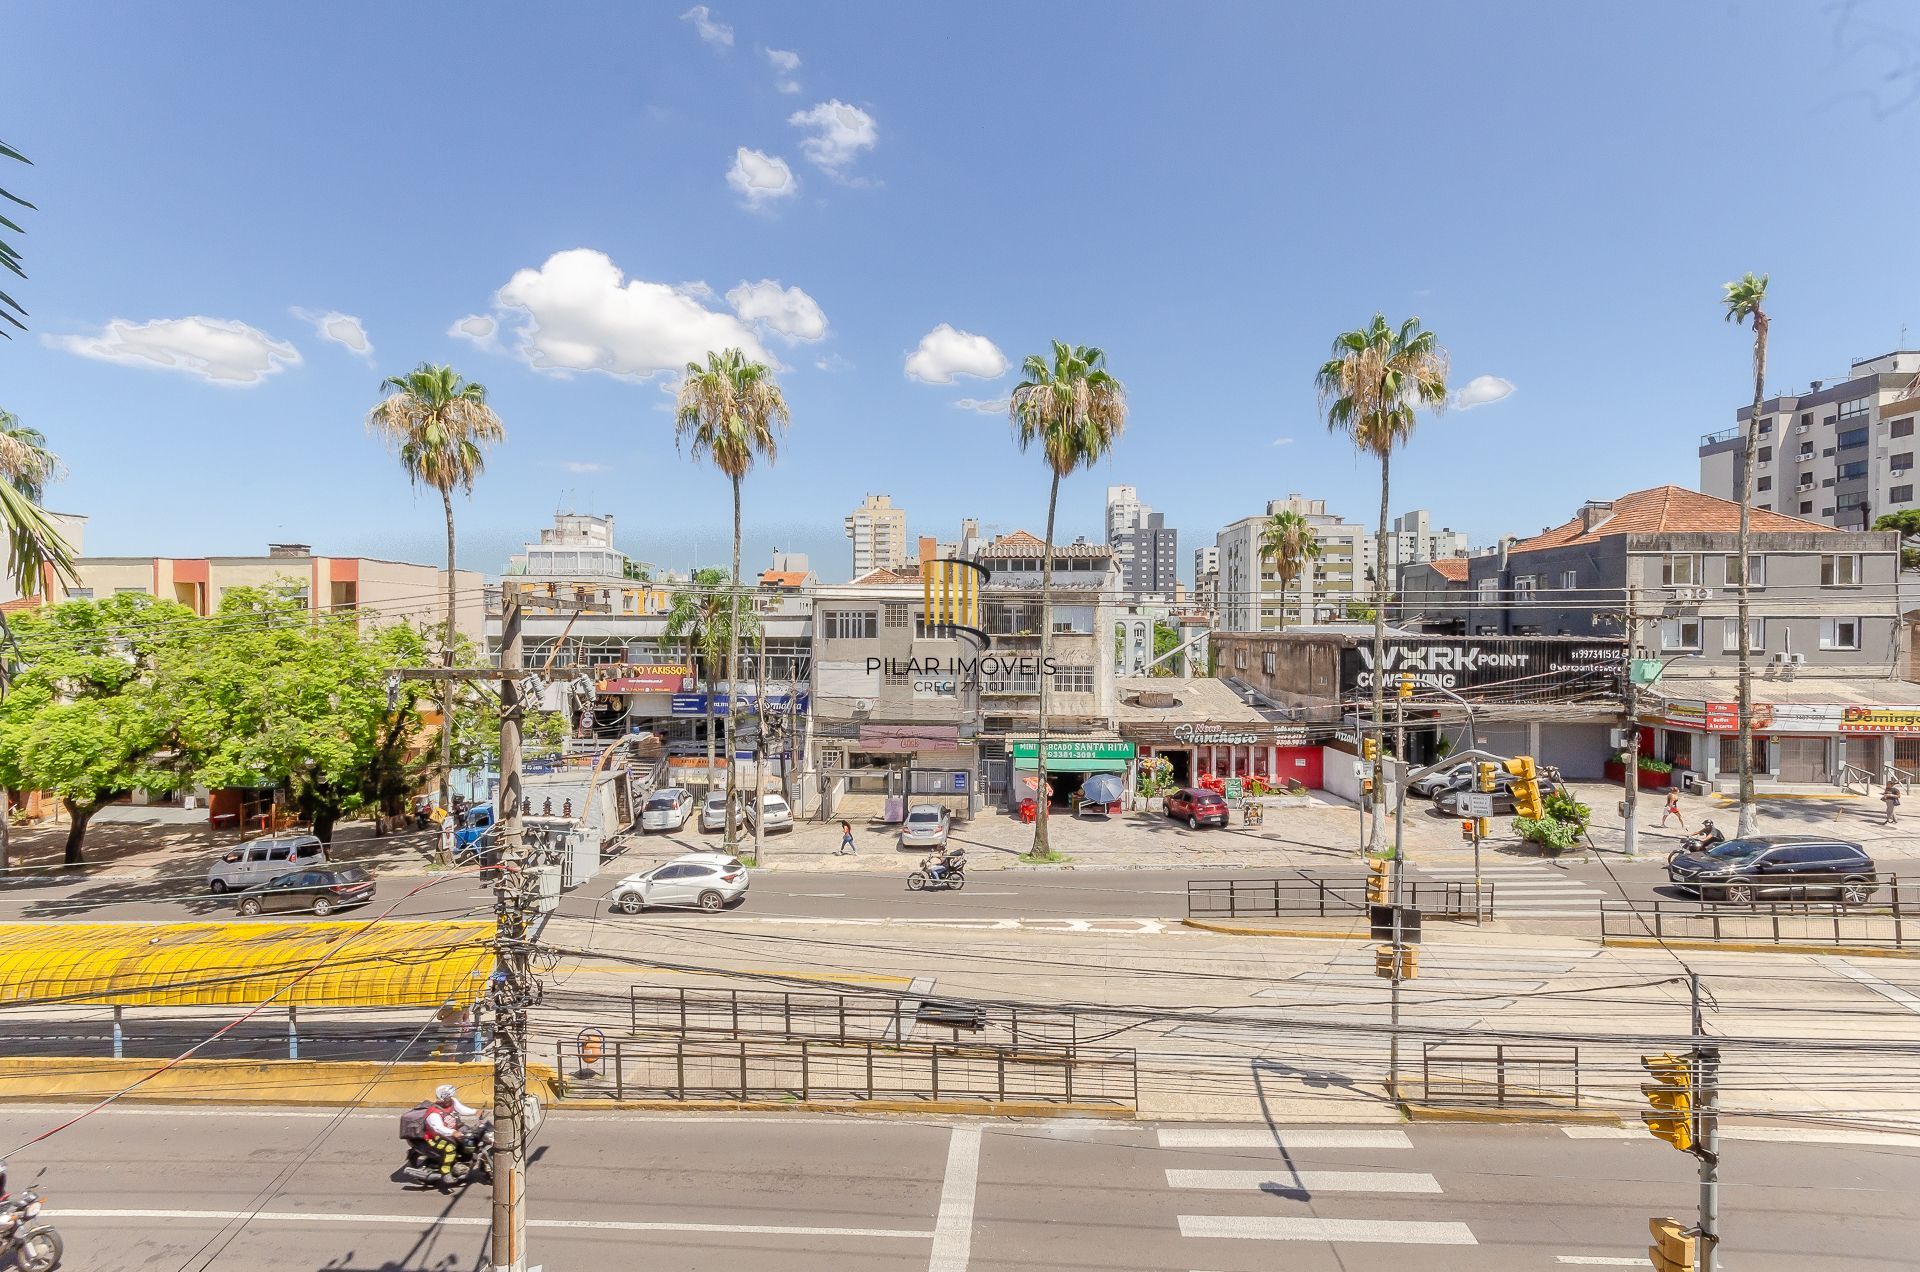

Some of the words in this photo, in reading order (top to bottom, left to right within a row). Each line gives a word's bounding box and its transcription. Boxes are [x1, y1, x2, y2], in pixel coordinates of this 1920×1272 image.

[1478, 654, 1529, 667] POINT
[1046, 743, 1072, 751] RCADO
[1074, 743, 1105, 751] SANTA
[1107, 743, 1129, 751] RITA
